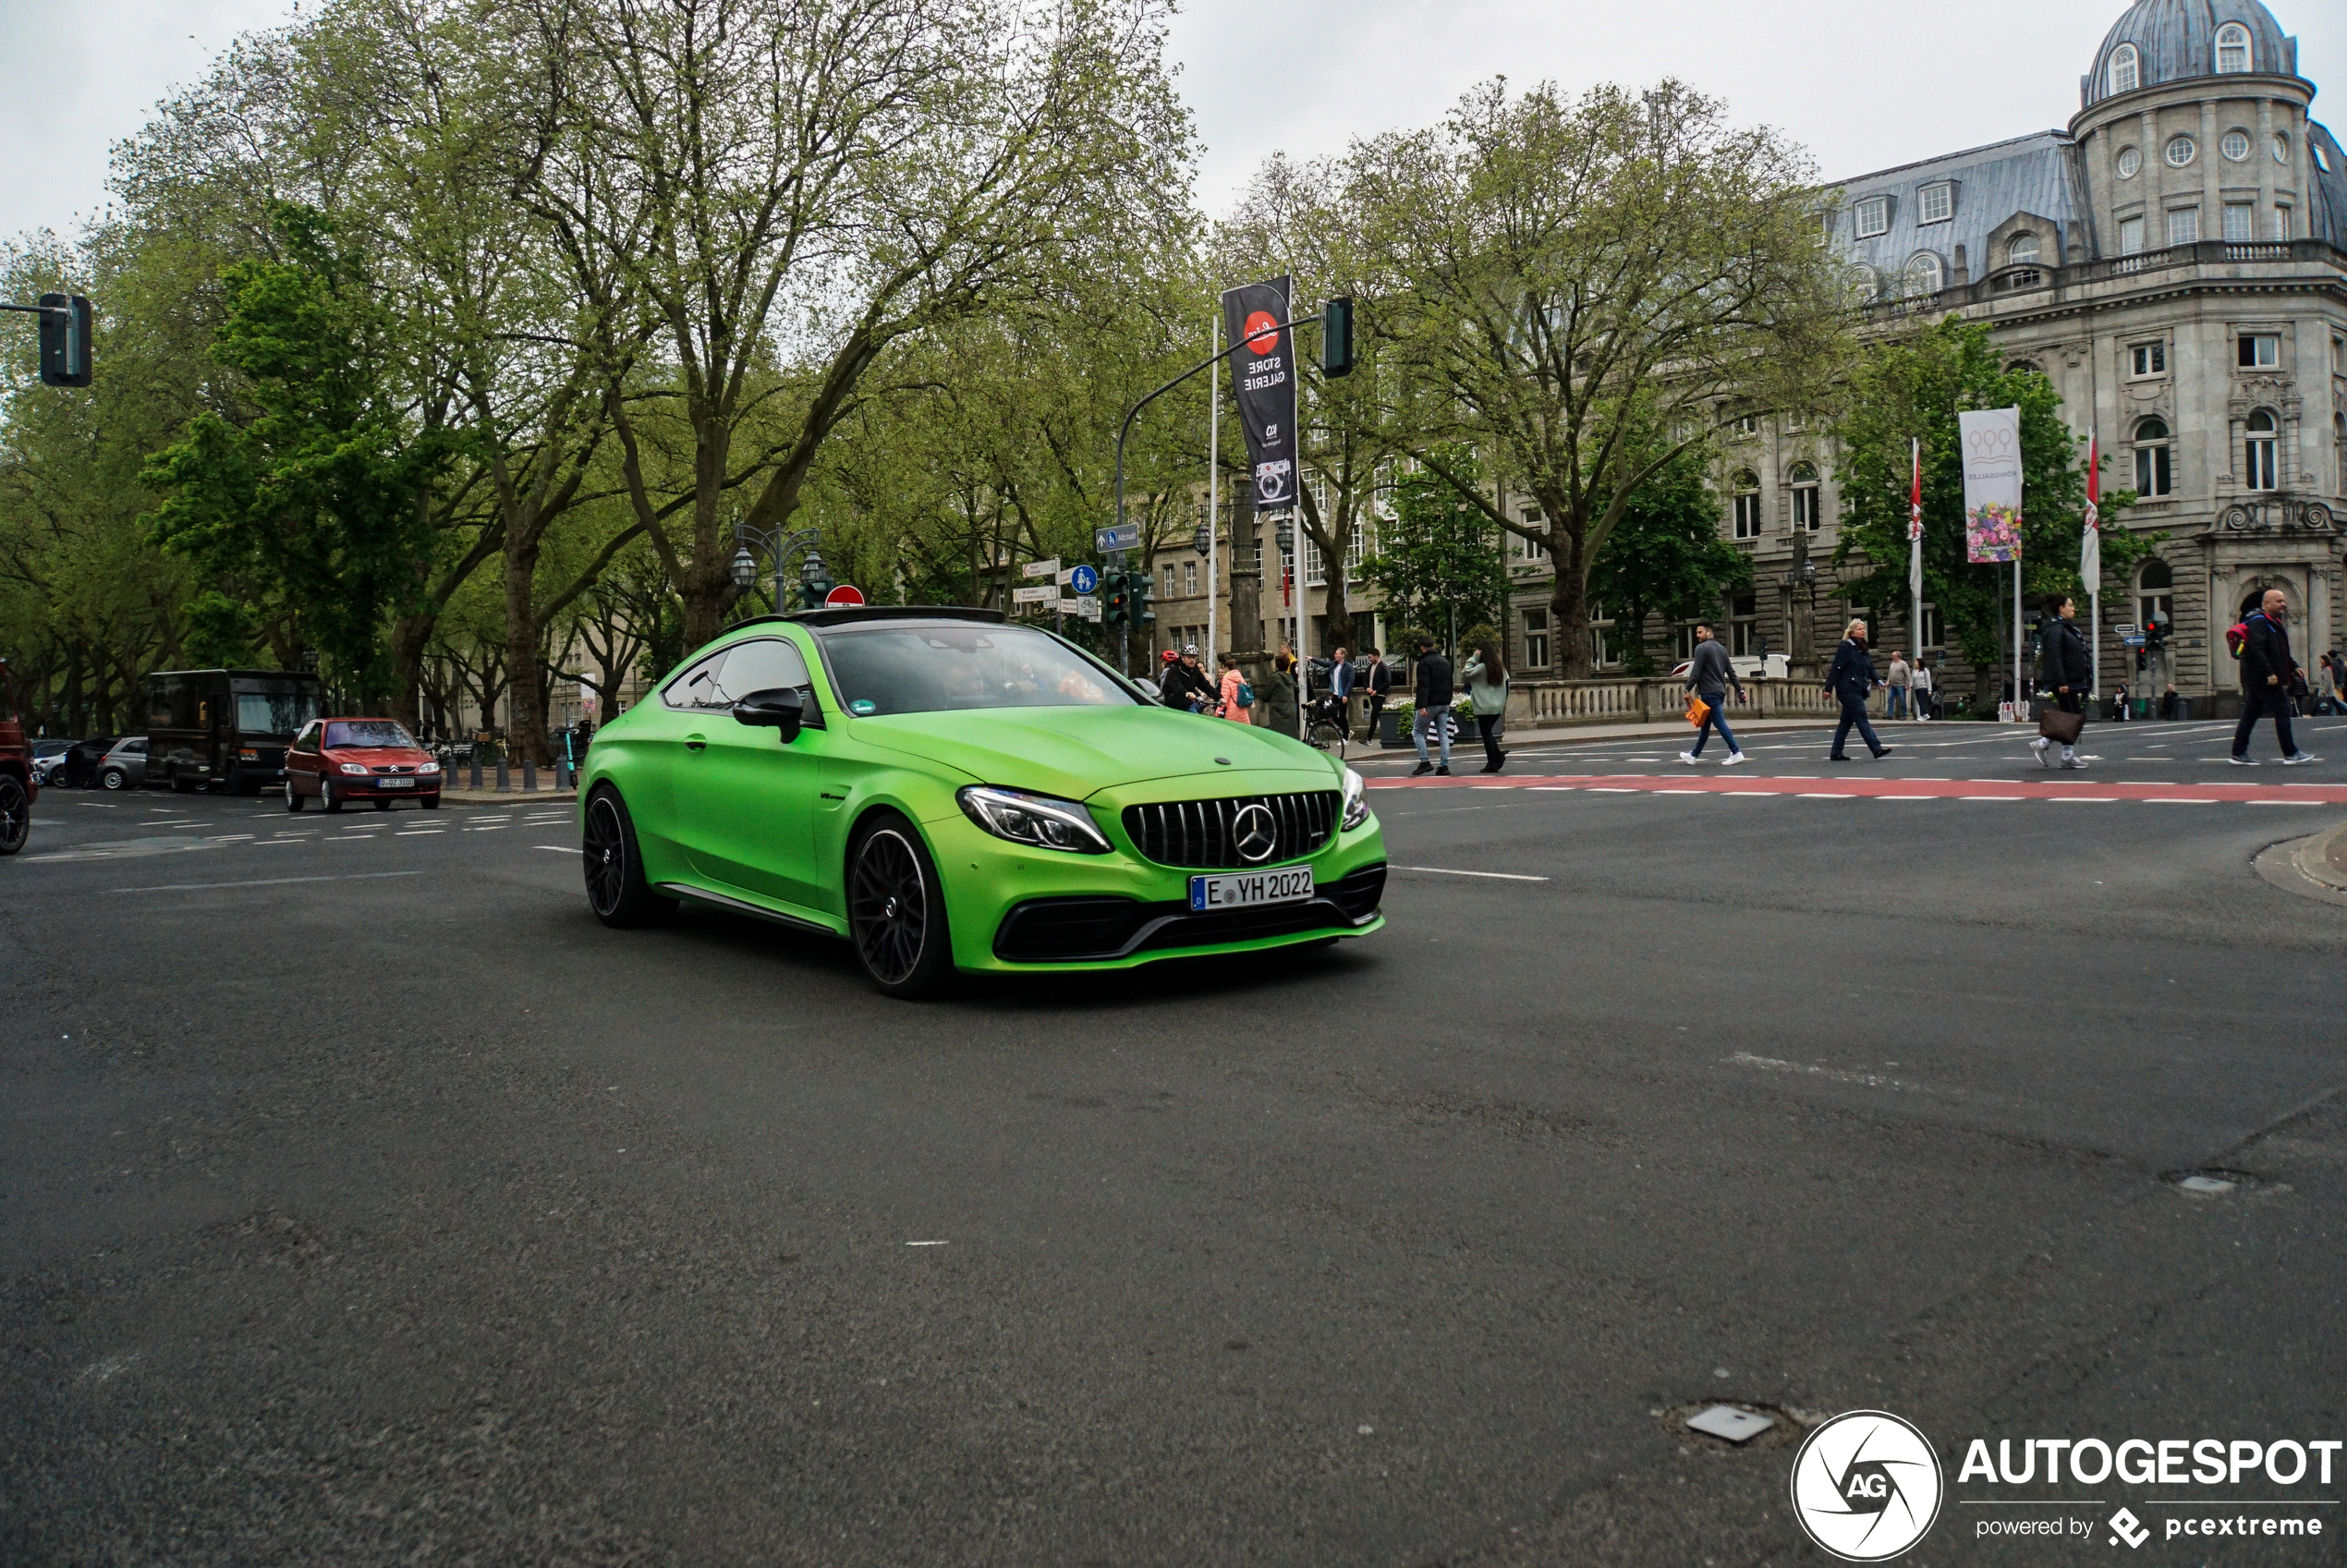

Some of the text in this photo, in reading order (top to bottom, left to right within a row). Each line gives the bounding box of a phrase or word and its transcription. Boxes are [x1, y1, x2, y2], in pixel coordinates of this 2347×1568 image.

[1208, 870, 1311, 905] E YH 2022
